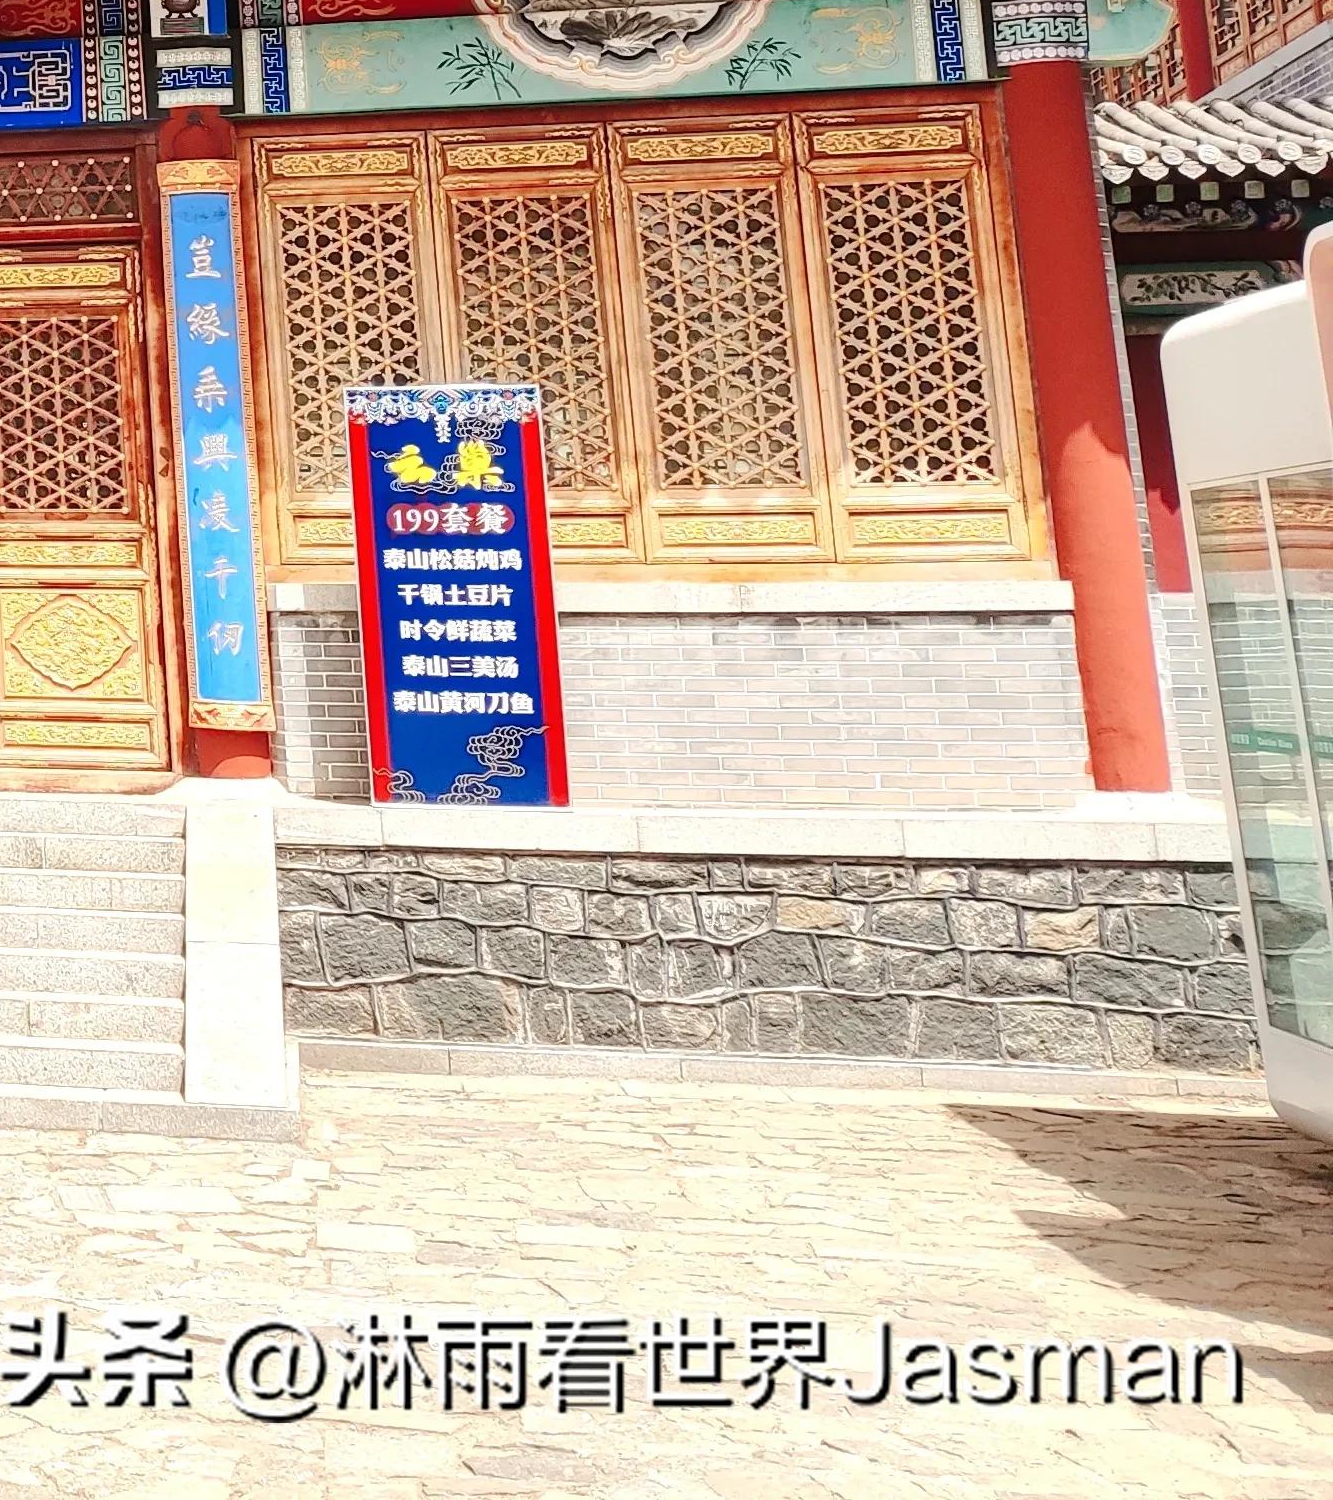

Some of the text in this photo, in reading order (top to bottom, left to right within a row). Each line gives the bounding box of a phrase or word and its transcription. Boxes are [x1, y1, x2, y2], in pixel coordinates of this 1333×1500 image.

[391, 502, 509, 534] 199套餐
[397, 584, 514, 606] 干锅土豆片
[400, 619, 517, 642] 时令鲜蔬菜
[402, 655, 519, 678] 泰山三美汤
[393, 690, 534, 714] 泰山黄河刀鱼
